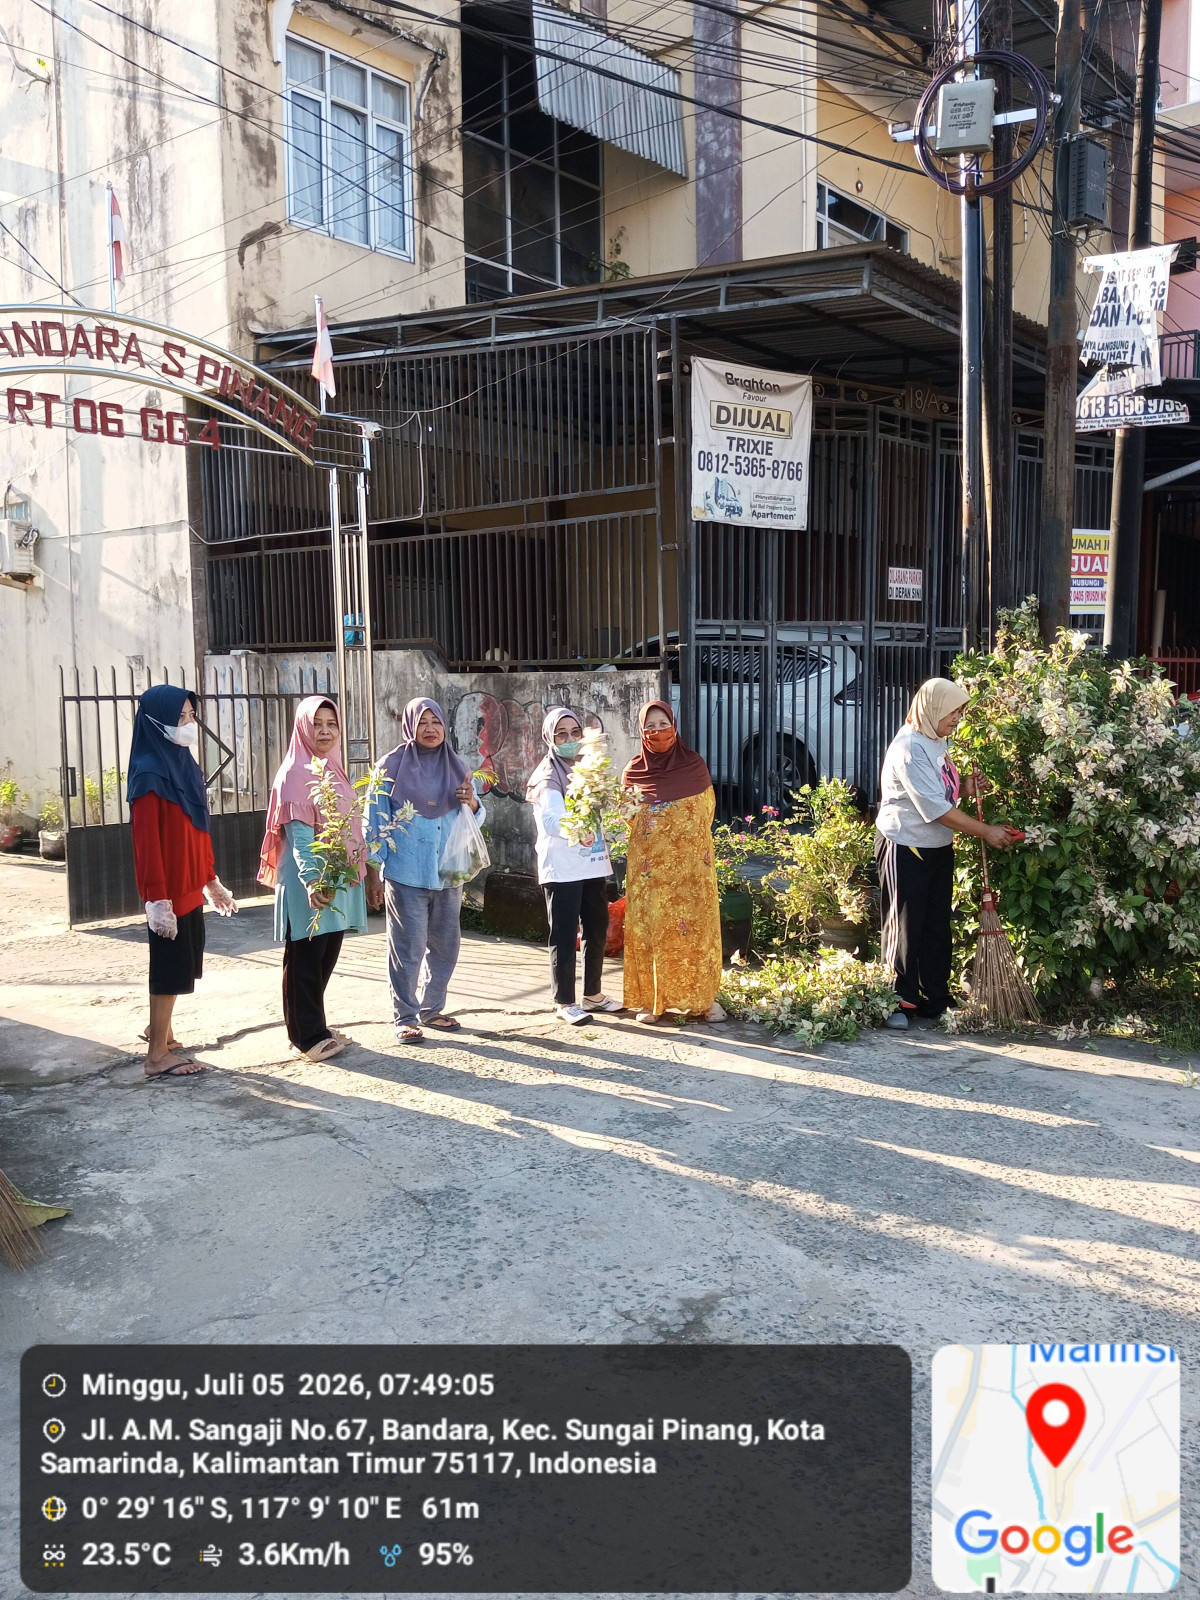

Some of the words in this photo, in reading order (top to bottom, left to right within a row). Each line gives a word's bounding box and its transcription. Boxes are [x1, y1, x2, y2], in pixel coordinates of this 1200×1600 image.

[1097, 340, 1129, 351] LANGSUNG
[1091, 351, 1129, 361] DILIHAT
[725, 372, 781, 393] Brighton
[161, 341, 186, 379] S
[196, 354, 318, 449] PINANG
[743, 391, 767, 403] Favour
[1108, 396, 1145, 417] 5156
[7, 388, 60, 429] RT
[73, 398, 125, 438] 06
[140, 407, 191, 447] GG
[199, 417, 221, 450] 4
[715, 405, 786, 432] DIJUAL
[726, 436, 773, 456] TRIXIE
[698, 451, 803, 482] 0812-5365-8766
[890, 569, 908, 584] DILARANG
[909, 570, 922, 585] PARKIR
[1072, 579, 1100, 587] HUBUNGI
[889, 587, 895, 598] DI
[895, 587, 910, 598] DEPAN
[911, 588, 922, 599] SINI
